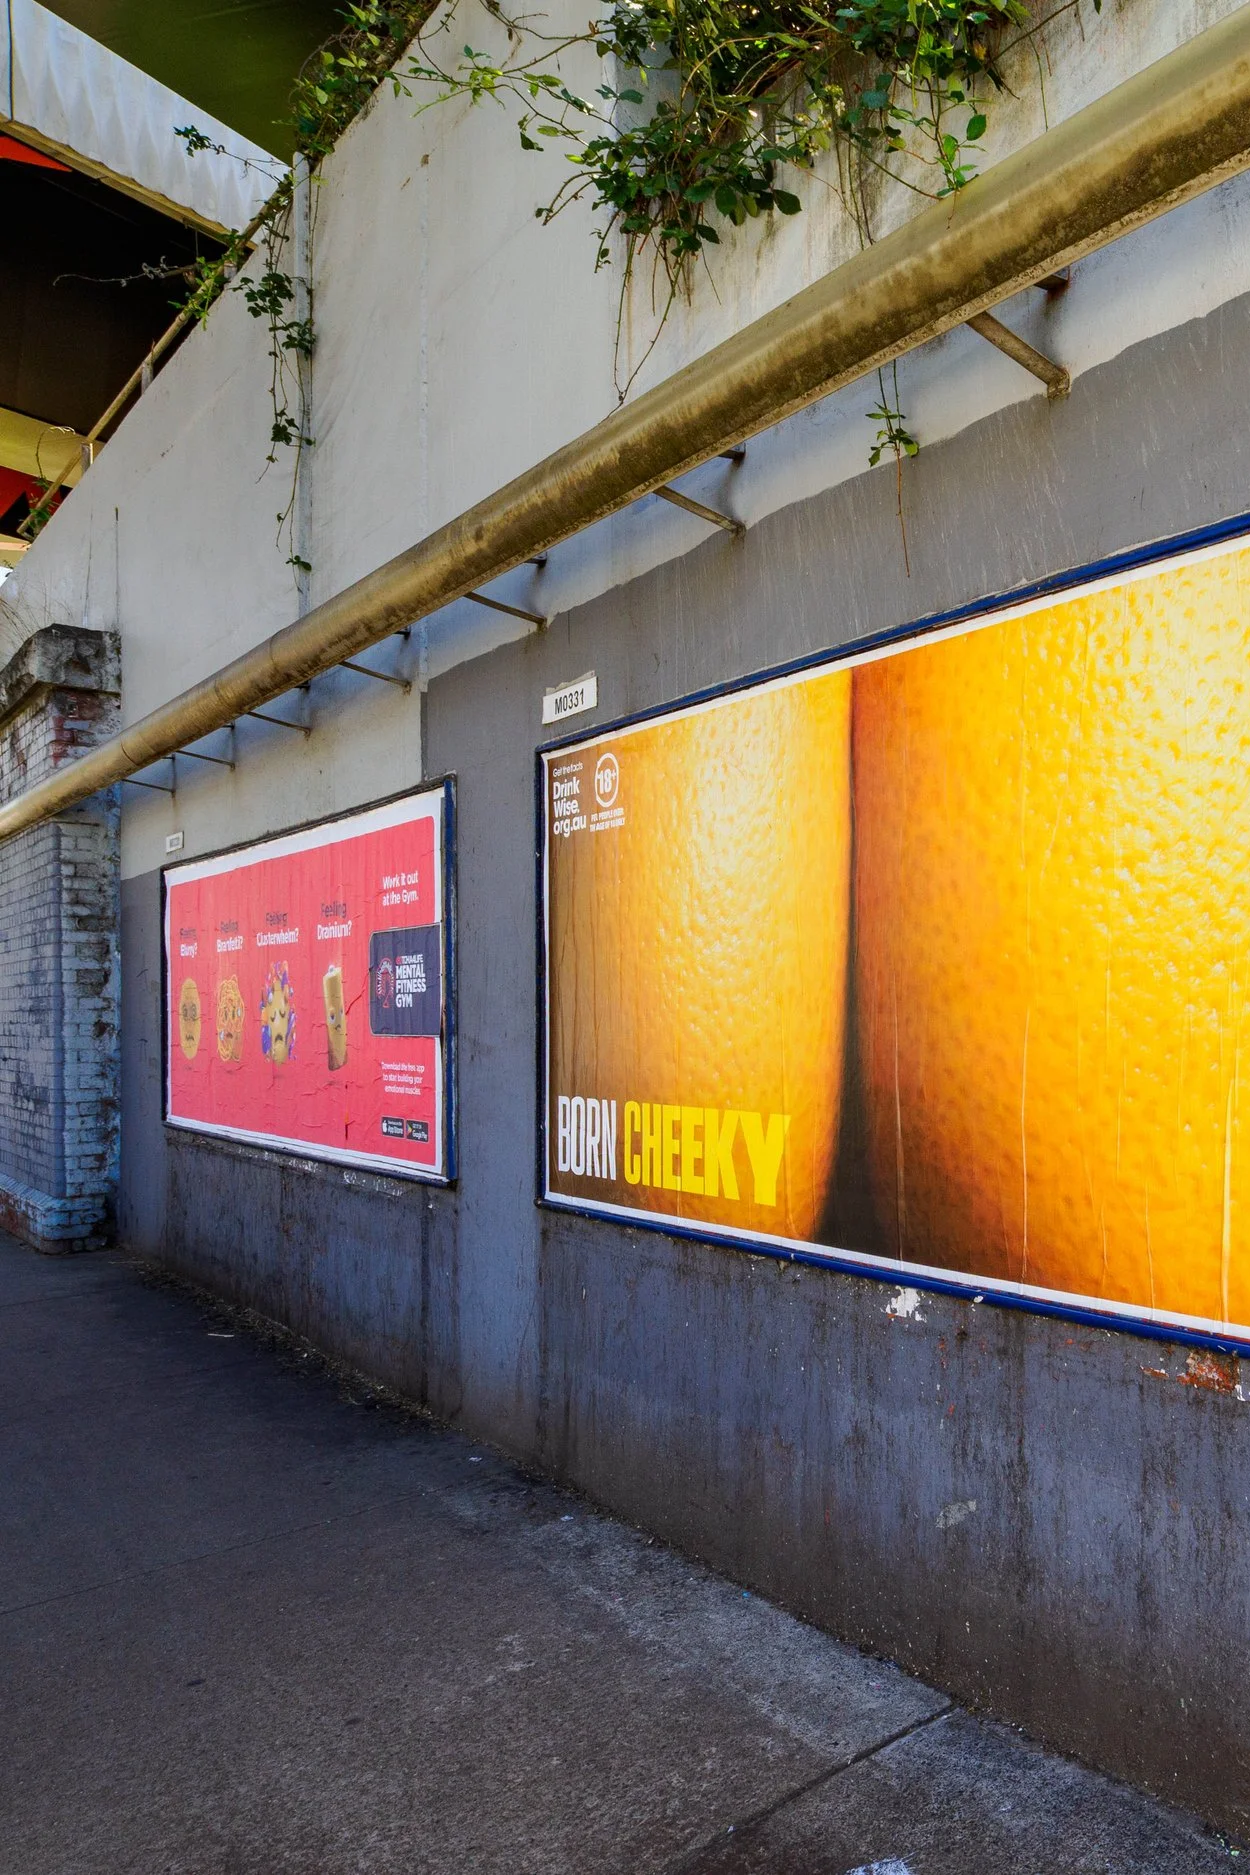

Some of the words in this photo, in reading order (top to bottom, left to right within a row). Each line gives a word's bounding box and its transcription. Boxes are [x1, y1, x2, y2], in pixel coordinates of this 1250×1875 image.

[554, 688, 585, 715] M0331
[552, 776, 580, 800] Drink
[597, 768, 617, 794] 18+
[553, 798, 580, 818] Wise.
[553, 815, 587, 838] org.au
[382, 874, 400, 889] Work
[401, 872, 406, 886] it
[407, 870, 419, 885] out
[382, 893, 389, 907] at
[390, 891, 401, 905] the
[395, 963, 426, 979] MENTAL
[395, 978, 427, 993] FITNESS
[395, 993, 413, 1008] GYM
[558, 1095, 617, 1181] BORN
[624, 1100, 792, 1207] CHEEKY
